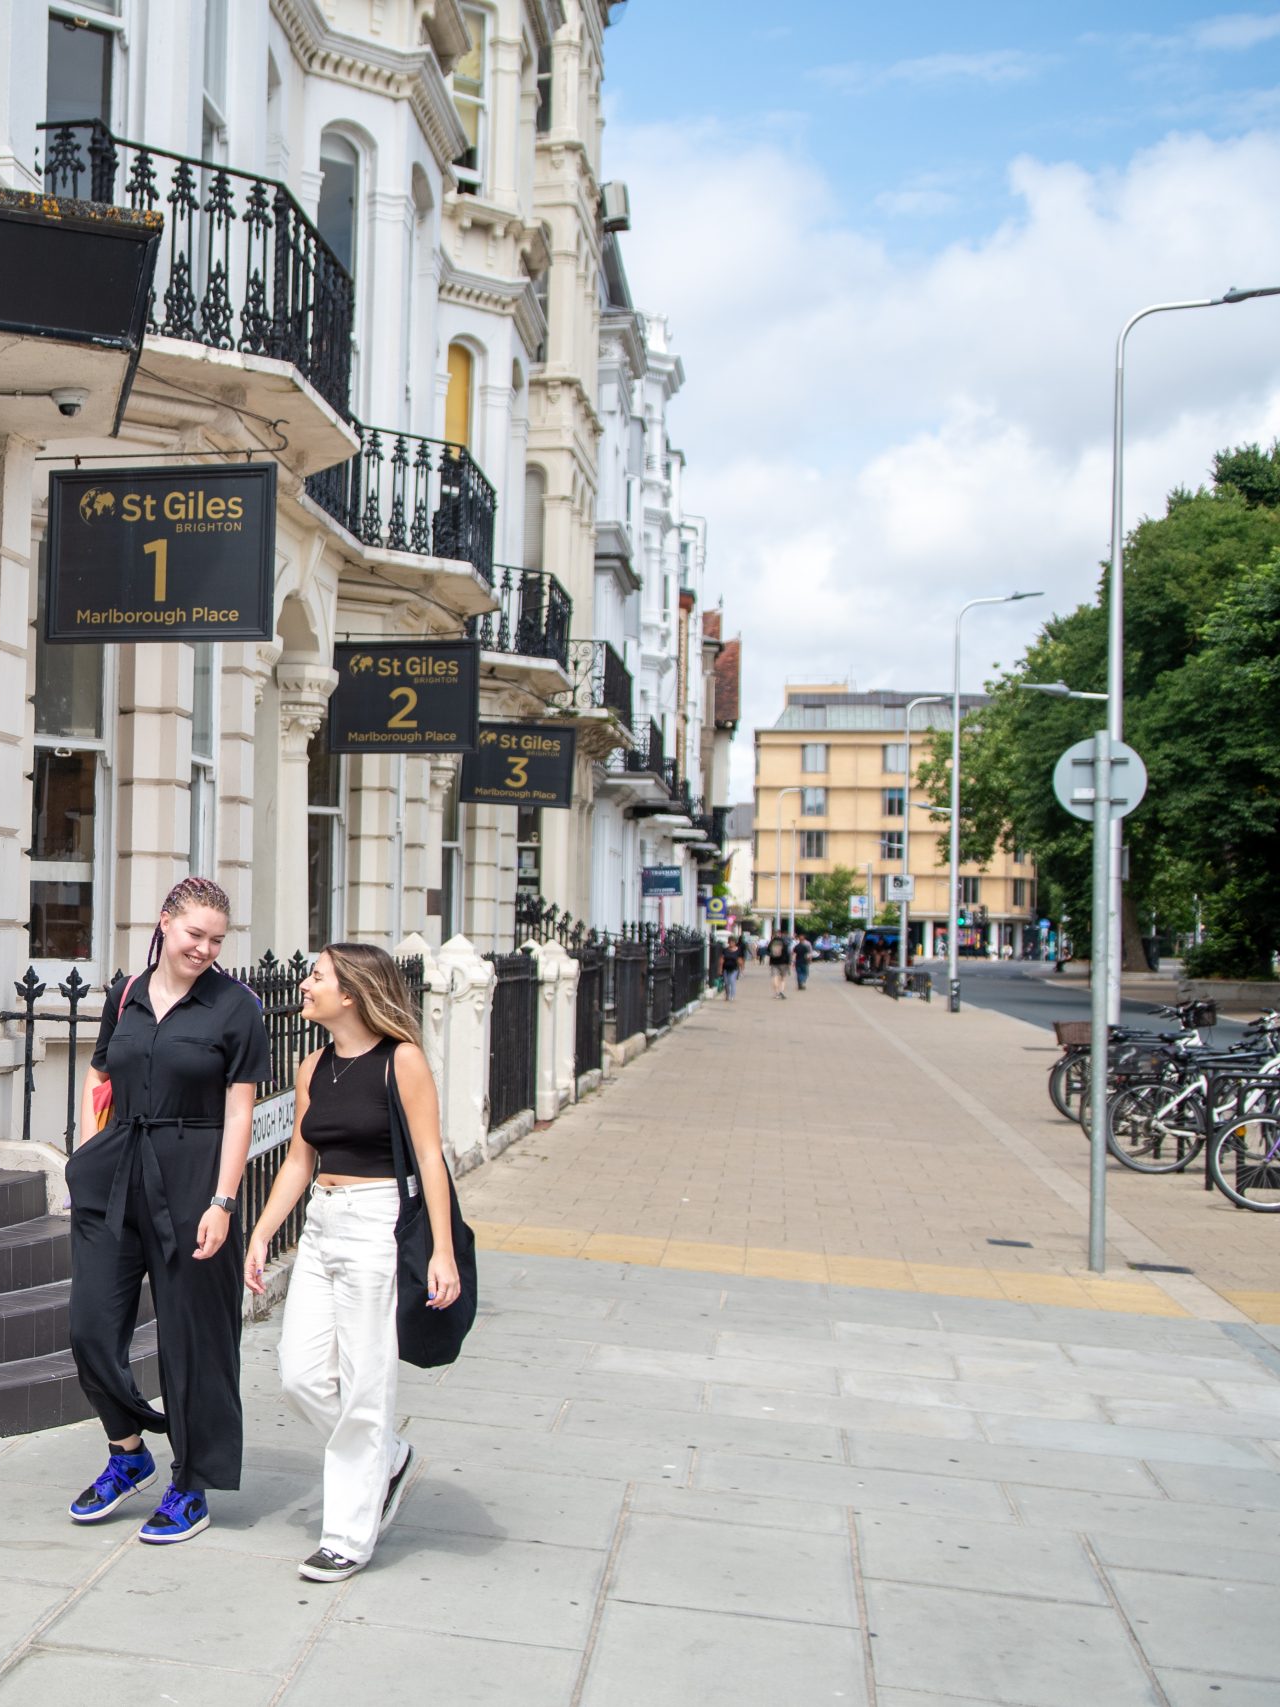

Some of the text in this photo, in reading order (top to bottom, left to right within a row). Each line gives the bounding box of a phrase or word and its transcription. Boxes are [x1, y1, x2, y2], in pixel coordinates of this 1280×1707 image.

[121, 490, 244, 522] St Giles
[175, 522, 242, 533] BRIGHTON
[143, 538, 168, 602] 1
[76, 607, 240, 625] Marlborough Place
[377, 655, 459, 676] St Giles
[413, 676, 458, 684] BRIGHTON
[387, 686, 418, 728] 2
[347, 731, 457, 743] Marlborough Place
[500, 734, 561, 751] St Giles
[504, 756, 529, 788] 3
[475, 787, 557, 800] Marlborough Place
[253, 1102, 295, 1145] ROUGH PLAC
